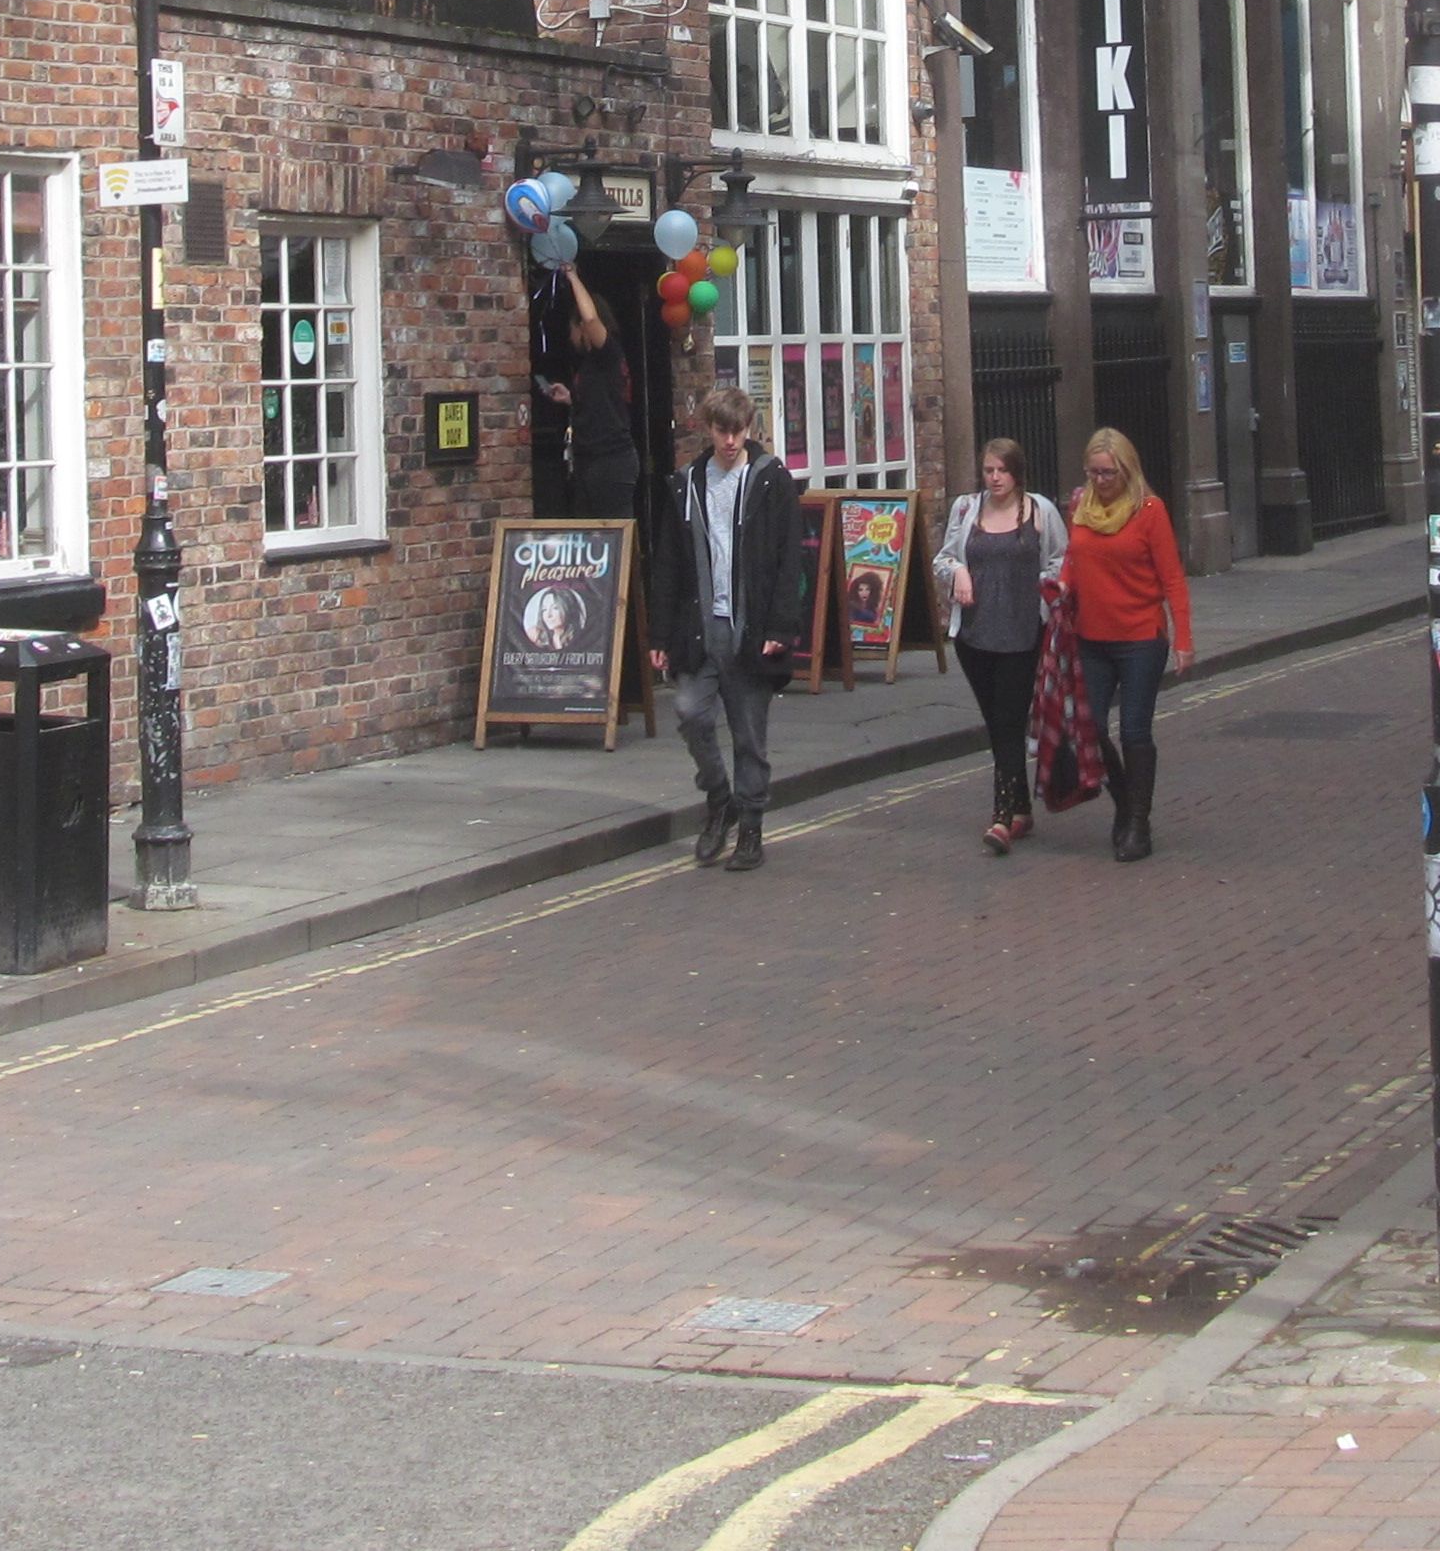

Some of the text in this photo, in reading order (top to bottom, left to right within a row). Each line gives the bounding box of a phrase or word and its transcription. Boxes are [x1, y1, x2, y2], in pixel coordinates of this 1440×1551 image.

[157, 63, 174, 74] THIS
[160, 133, 177, 142] AREA
[520, 561, 603, 589] pleasures
